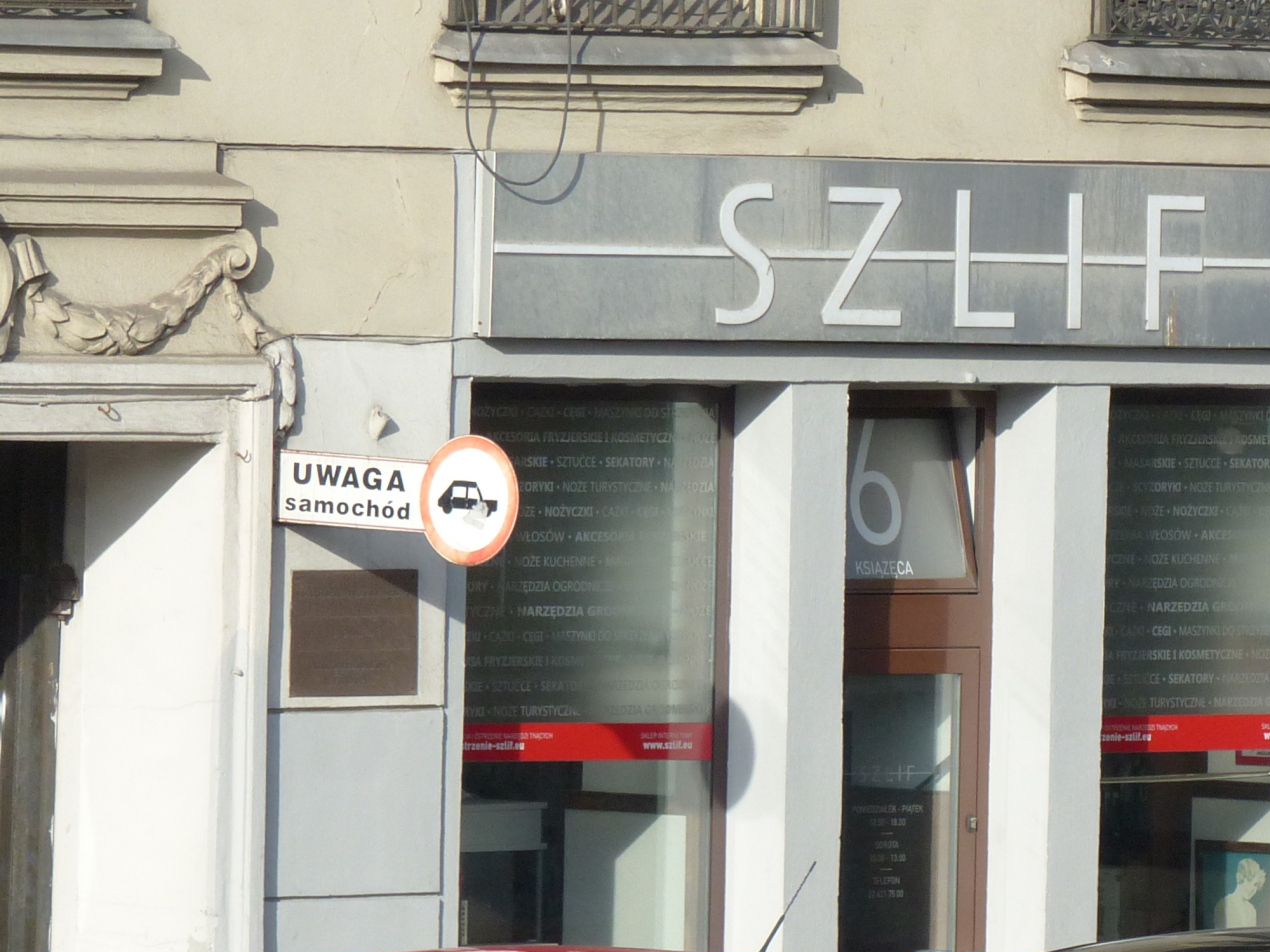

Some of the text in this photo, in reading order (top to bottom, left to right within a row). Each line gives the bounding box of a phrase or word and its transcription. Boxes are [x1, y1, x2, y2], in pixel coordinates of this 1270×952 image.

[714, 183, 1204, 330] SZLIF
[605, 457, 654, 468] SEKATORY
[293, 462, 406, 492] UWAGA
[850, 419, 902, 546] 6
[285, 497, 411, 521] samochód
[1179, 650, 1243, 660] KOSMETYCZNE
[1168, 674, 1214, 684] SEKATORY
[1150, 697, 1207, 708] TURYSTYCZNE
[643, 741, 692, 750] www.szlif.eu
[860, 766, 915, 782] SZLIF
